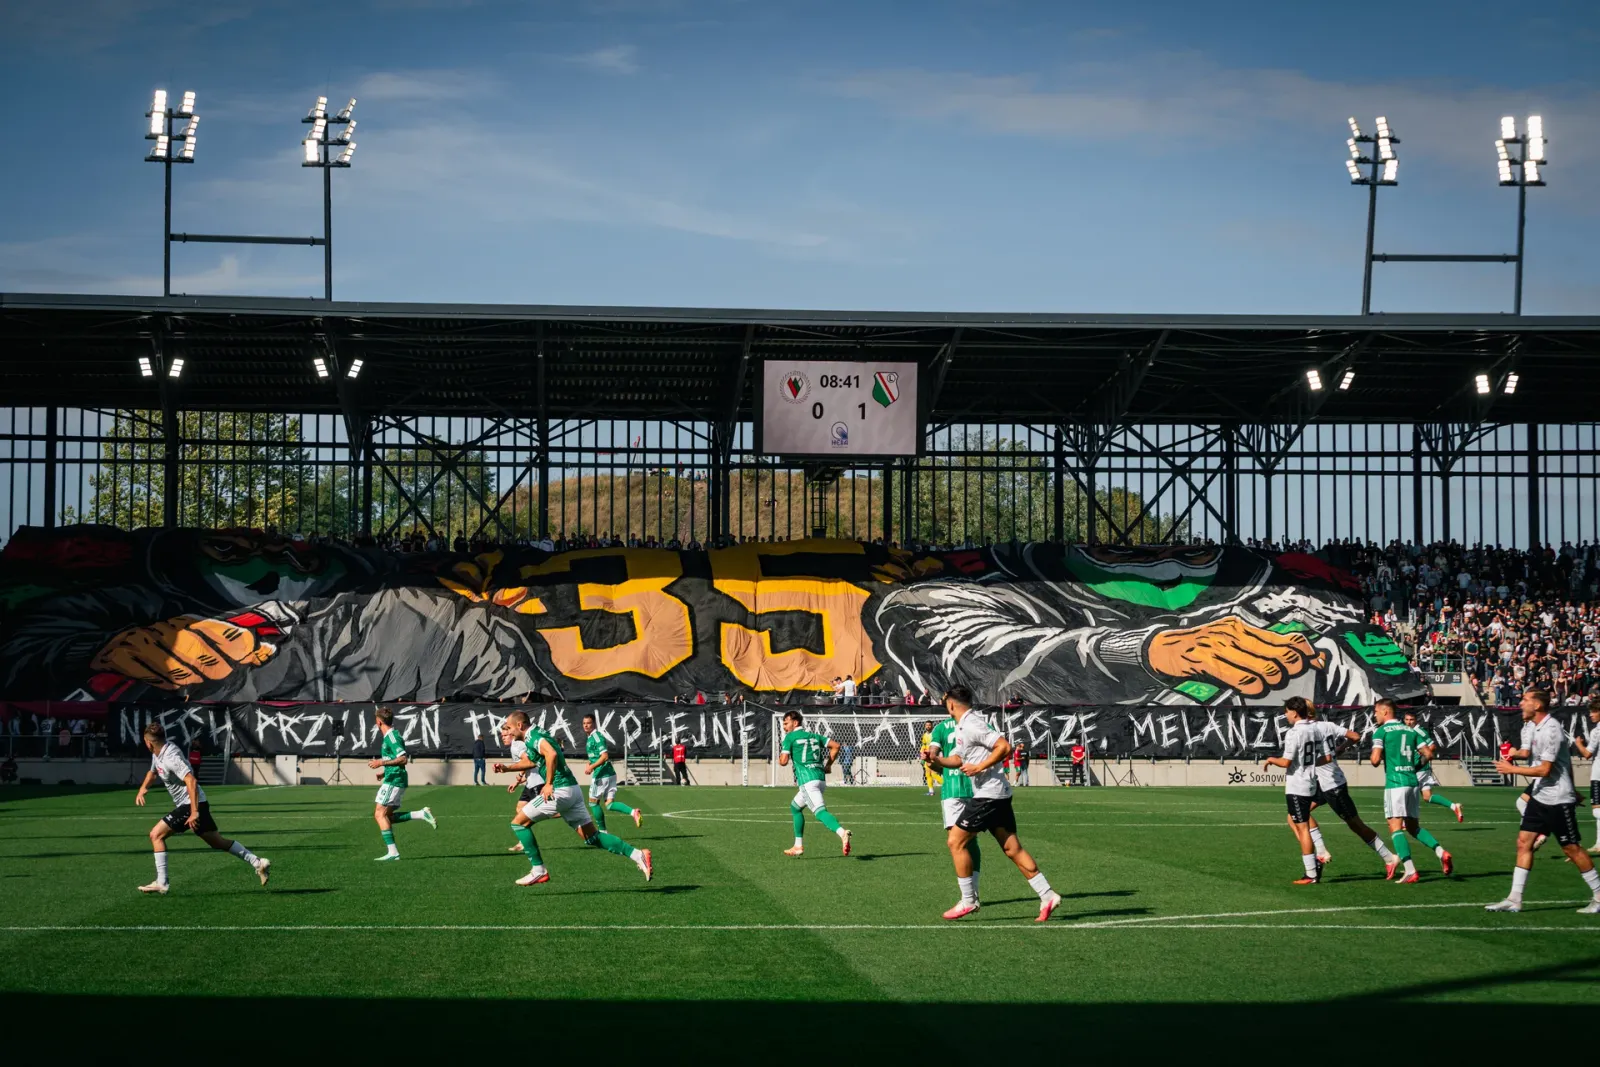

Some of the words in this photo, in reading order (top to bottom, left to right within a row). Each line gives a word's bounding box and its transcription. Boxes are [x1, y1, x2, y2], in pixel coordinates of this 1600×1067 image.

[820, 375, 860, 388] 08:41
[812, 402, 824, 419] 0
[858, 403, 866, 420] 1
[1435, 674, 1445, 683] 07
[120, 706, 235, 746] NIECH
[593, 708, 757, 749] KOLEJNE
[796, 738, 820, 763] 75
[1400, 733, 1413, 763] 4
[1249, 771, 1288, 783] Sosnowi
